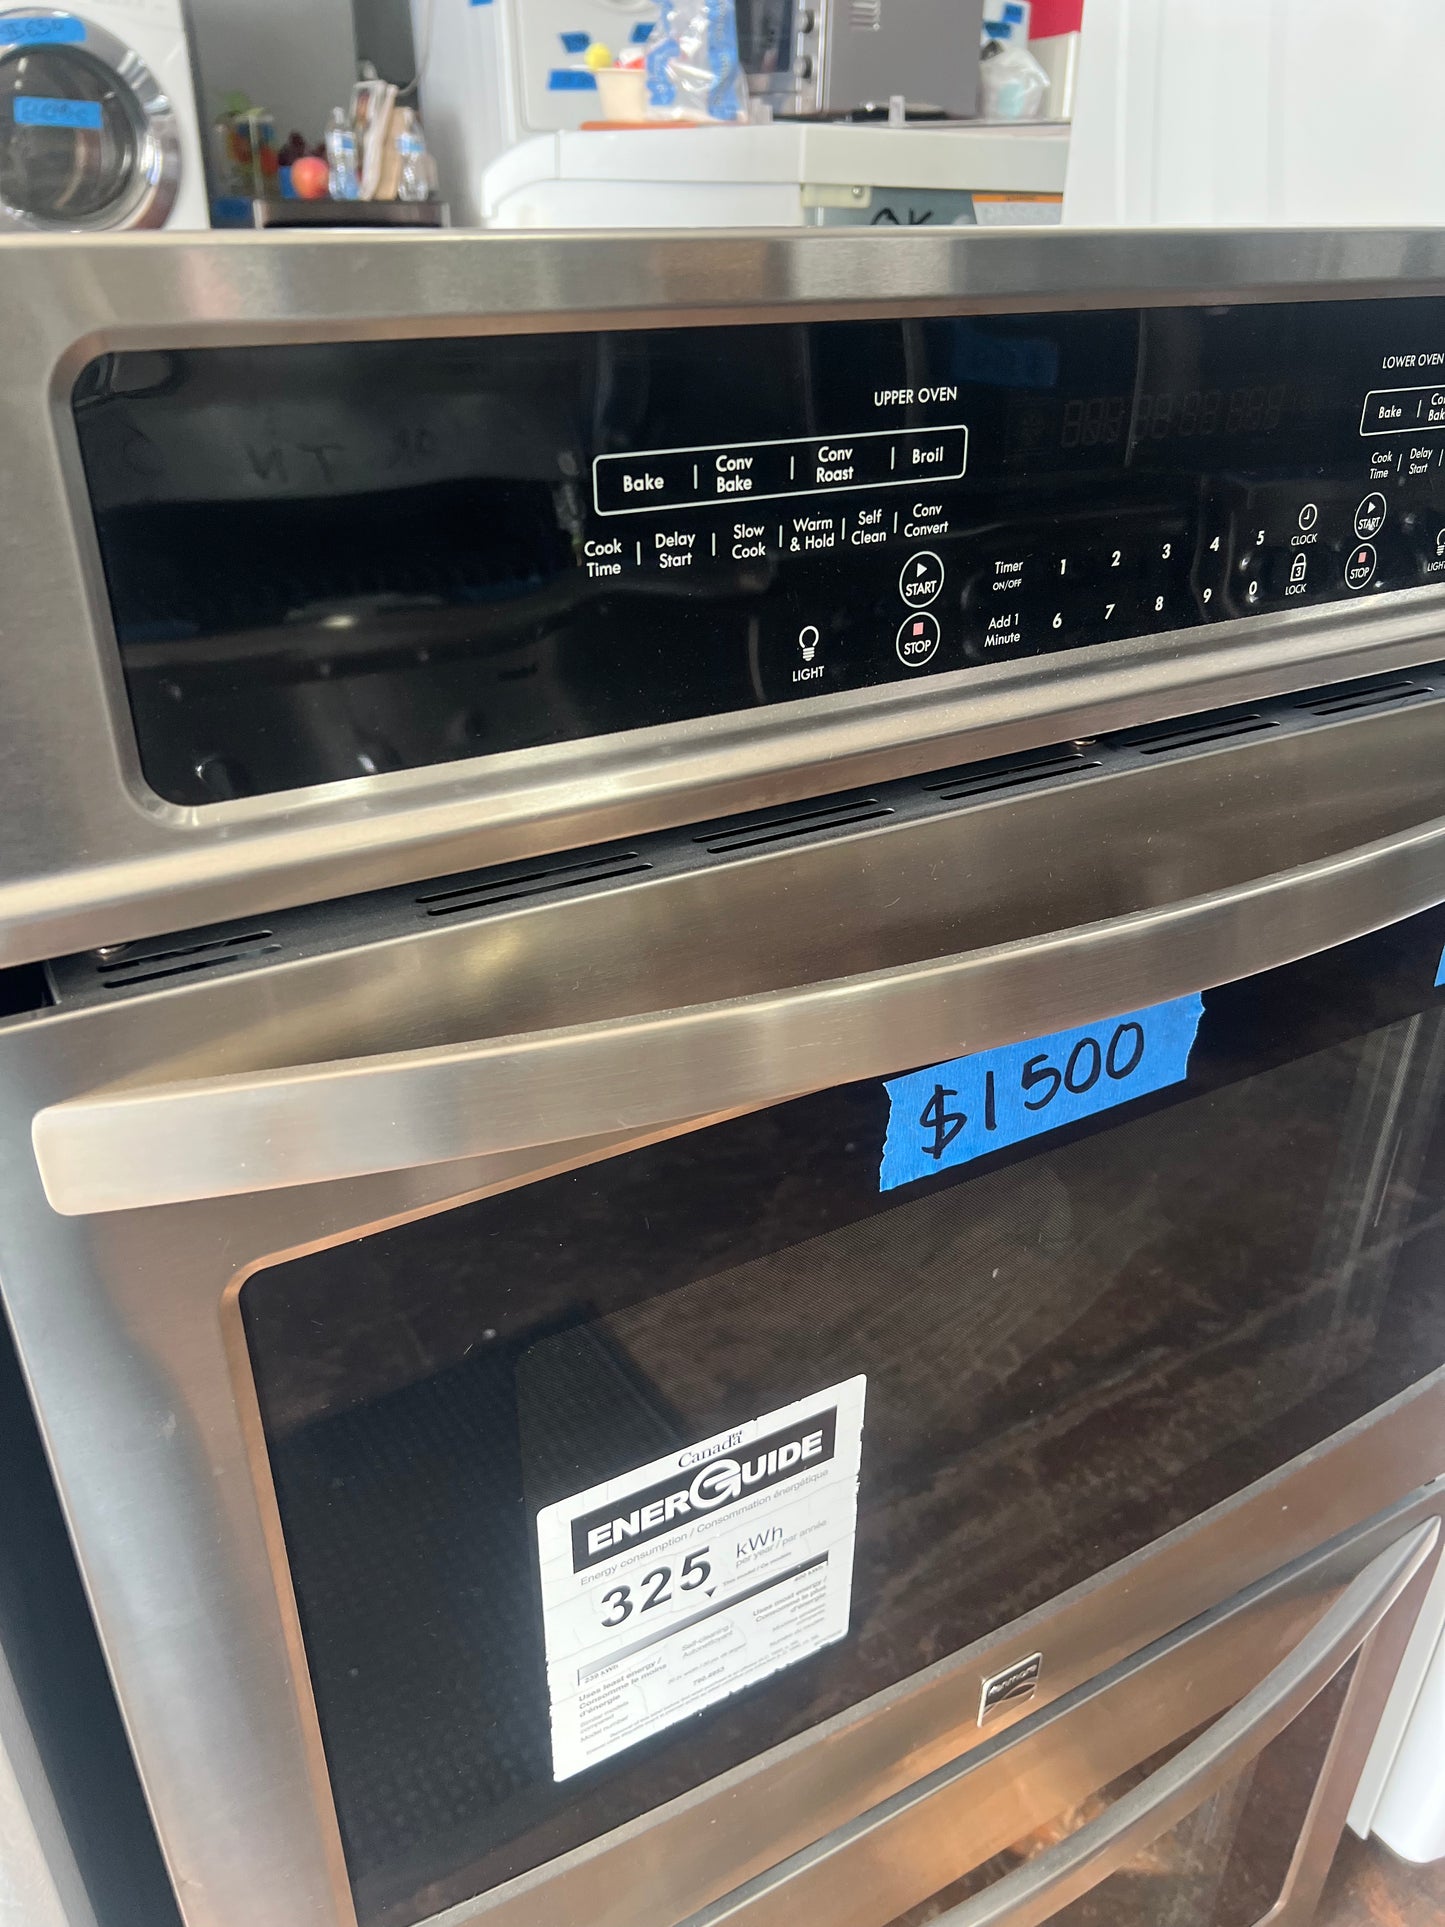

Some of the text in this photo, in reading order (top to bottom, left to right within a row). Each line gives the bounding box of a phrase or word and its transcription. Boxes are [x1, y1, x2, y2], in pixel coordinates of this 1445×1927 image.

[1382, 352, 1445, 369] LOWER OVEN
[874, 386, 958, 407] UPPER OVEN
[1378, 404, 1402, 419] Bake
[817, 445, 853, 463] Conv
[912, 445, 944, 465] Broil
[1371, 450, 1393, 464] Cook
[1409, 446, 1434, 460] Delay
[715, 454, 754, 473] Conv
[1408, 463, 1428, 475] Start
[623, 472, 665, 493] Bake
[816, 466, 854, 483] Roast
[1369, 468, 1389, 480] Time
[716, 474, 753, 493] Bake
[858, 508, 883, 526] Self
[912, 503, 943, 518] Conv
[733, 523, 765, 540] Slow
[792, 517, 835, 536] Warm
[903, 520, 949, 538] Convert
[1357, 516, 1381, 531] START
[655, 531, 696, 549] Delay
[789, 532, 835, 552] & Hold
[851, 529, 887, 546] Clean
[1290, 532, 1318, 546] CLOCK
[583, 538, 622, 557] Cook
[731, 541, 766, 560] Cook
[1060, 530, 1265, 575] 1 2 3 4 5
[659, 552, 693, 569] Start
[994, 561, 1024, 575] Timer
[586, 562, 622, 578] Time
[1349, 567, 1370, 580] STOP
[904, 579, 938, 596] START
[992, 578, 1022, 592] ON/OFF
[1284, 583, 1307, 596] LOCK
[1052, 579, 1258, 629] 6 7 8 9 0
[987, 613, 1019, 630] Add 1
[903, 639, 932, 656] STOP
[984, 632, 1021, 648] Minute
[792, 665, 825, 682] LIGHT
[919, 1021, 1145, 1160] $1500
[678, 1430, 743, 1468] Canada
[580, 1560, 618, 1587] Energy
[620, 1533, 688, 1567] consumption
[696, 1491, 771, 1534] Consommation
[736, 1525, 784, 1558] kWh
[600, 1545, 711, 1628] 325
